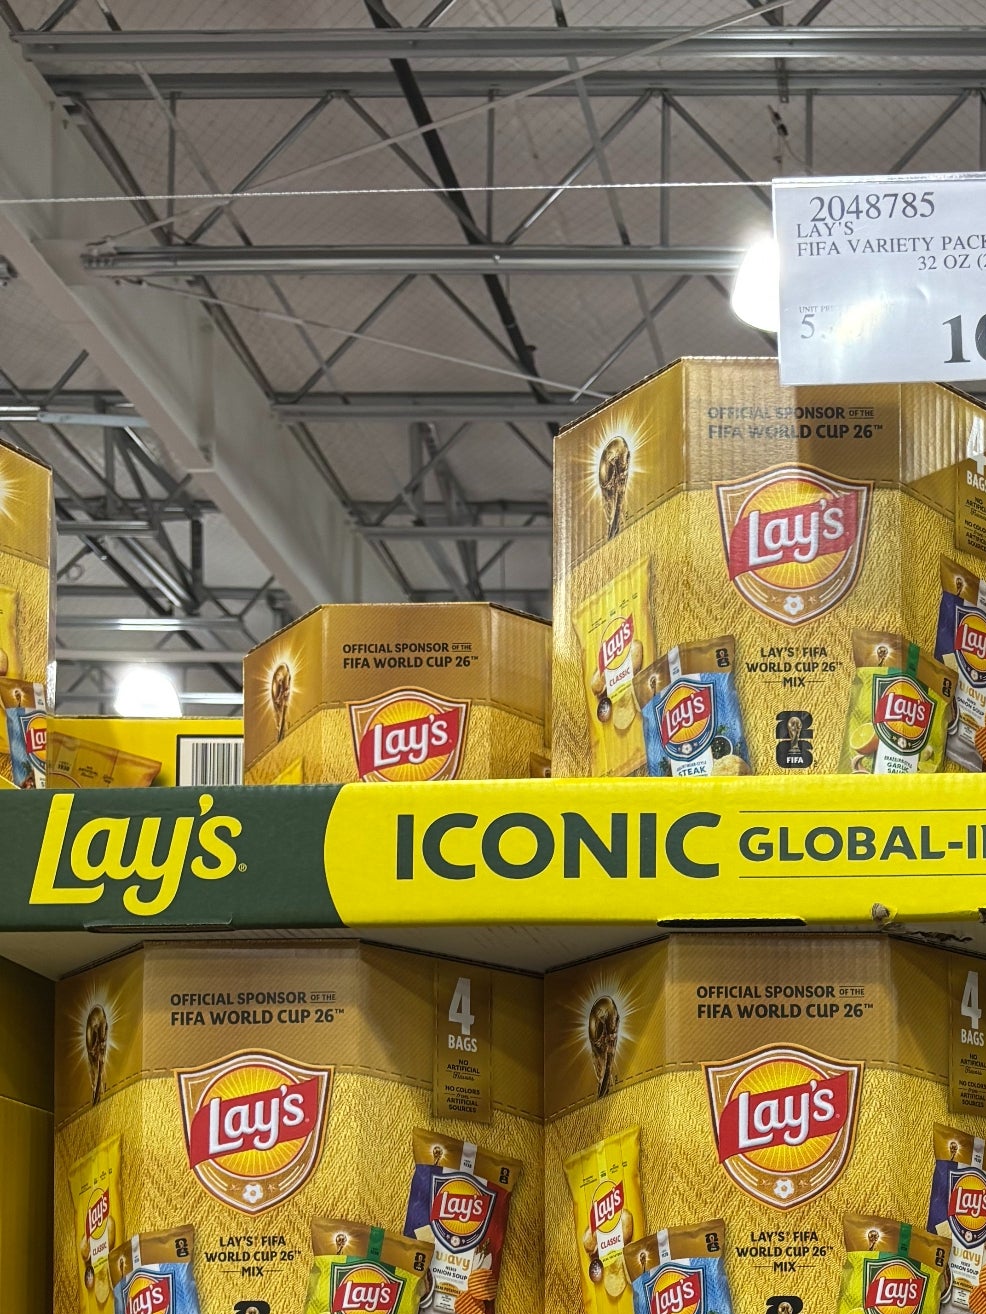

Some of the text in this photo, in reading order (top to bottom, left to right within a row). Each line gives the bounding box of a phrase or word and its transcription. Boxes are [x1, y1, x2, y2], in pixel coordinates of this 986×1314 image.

[809, 191, 935, 222] 2048785
[797, 221, 854, 238] LAY'S
[798, 239, 841, 257] FIFA
[848, 236, 935, 254] VARIETY
[918, 256, 937, 271] 32
[943, 255, 970, 269] OZ
[748, 499, 845, 567] Lay's
[343, 643, 393, 654] OFFICIAL
[395, 642, 449, 652] SPONSOR
[343, 657, 370, 669] FIFA
[373, 656, 423, 668] WORLD
[427, 656, 452, 668] CUP
[373, 712, 448, 766] Lay's
[29, 793, 242, 916] Lay's
[397, 812, 722, 881] ICONIC
[696, 985, 865, 999] OFFICIAL SPONSOR OF THE
[449, 977, 474, 1035] 4
[697, 1004, 732, 1018] FIFA
[737, 1003, 802, 1018] WORLD
[805, 1003, 840, 1018] CUP
[448, 1034, 477, 1052] BAGS
[209, 1085, 305, 1154] Lay's
[738, 1079, 834, 1148] Lay's
